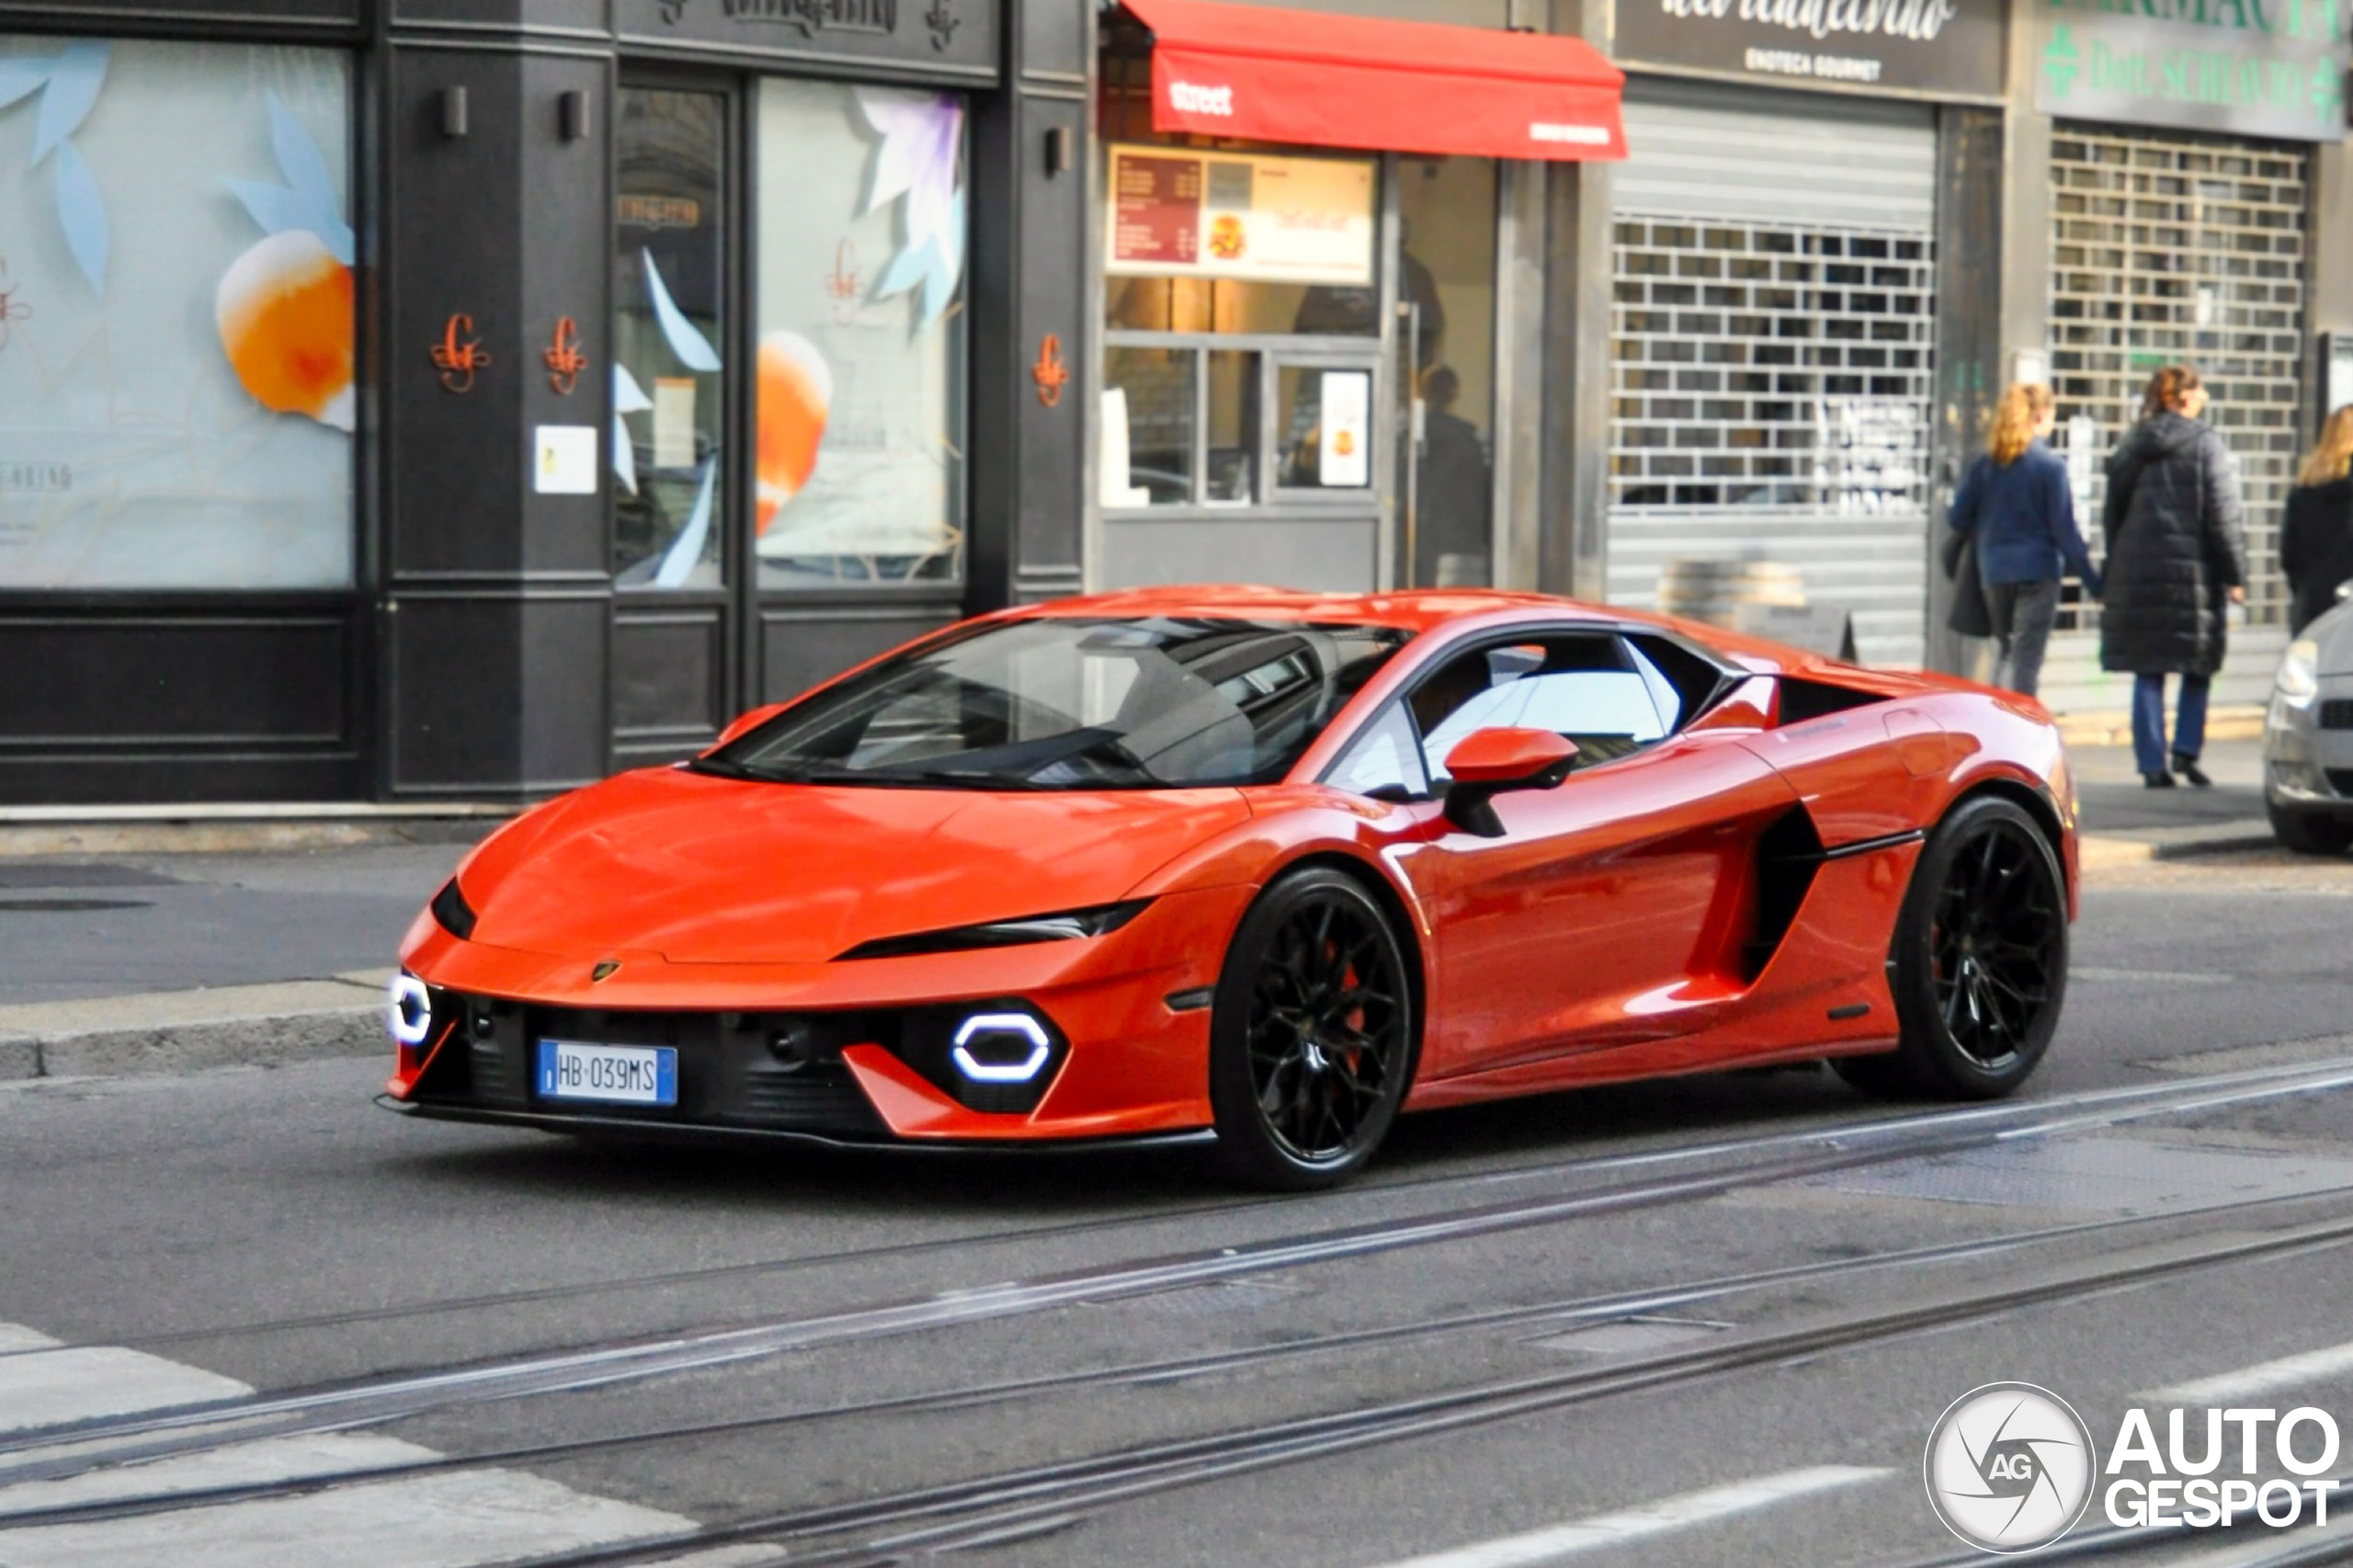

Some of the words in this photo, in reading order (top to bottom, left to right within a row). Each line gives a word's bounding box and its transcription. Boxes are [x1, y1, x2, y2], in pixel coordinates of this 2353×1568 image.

[1813, 55, 1881, 82] GOURMET
[1169, 81, 1233, 116] street
[559, 1054, 582, 1086] HB
[591, 1057, 654, 1091] 039MS
